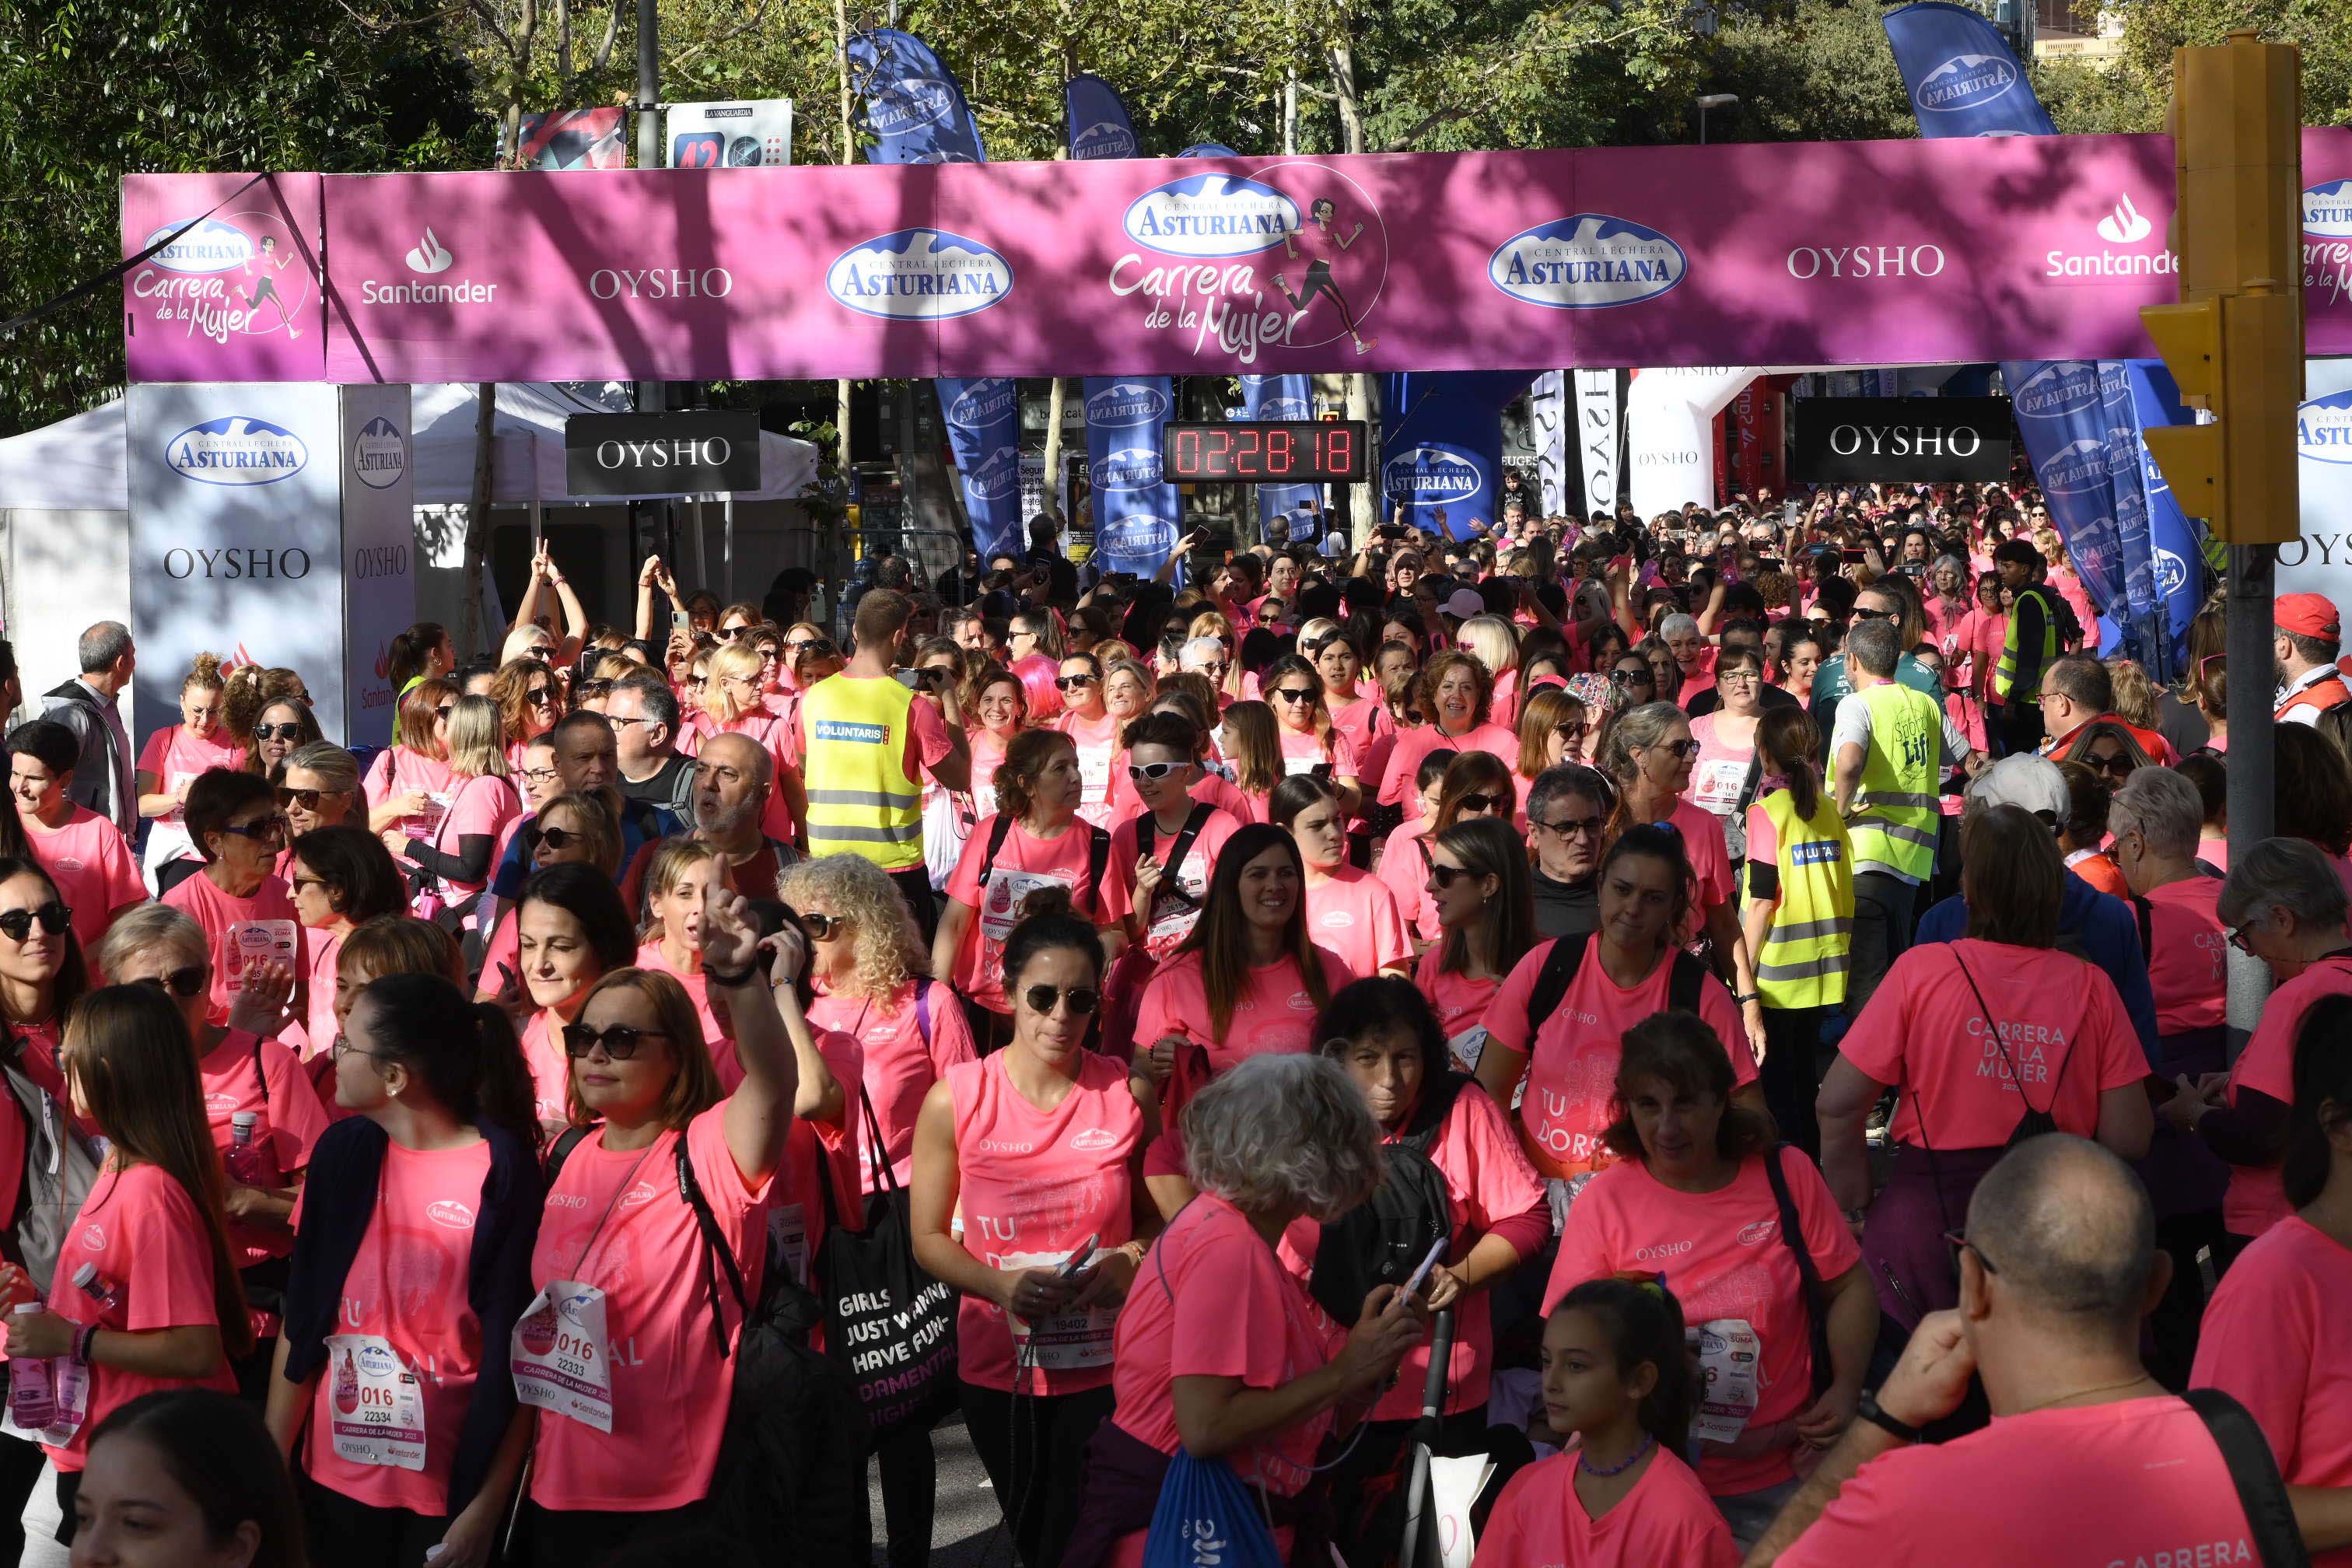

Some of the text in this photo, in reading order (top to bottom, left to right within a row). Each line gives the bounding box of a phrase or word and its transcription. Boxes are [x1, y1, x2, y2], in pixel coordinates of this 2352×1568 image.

[714, 108, 752, 117] VANGUARDIA
[1164, 200, 1283, 212] CENTRAL LECHERA
[1137, 205, 1288, 236] ASTURIANA
[870, 257, 993, 270] CENTRAL LECHERA
[1534, 245, 1665, 257] CENTRAL LECHERA
[1787, 244, 1945, 279] OYSHO
[842, 264, 999, 297] ASTURIANA
[1108, 253, 1255, 297] Carrera
[1503, 250, 1672, 285] ASTURIANA
[2302, 265, 2333, 287] e la
[133, 269, 226, 299] Carrera
[362, 278, 498, 304] Santander
[589, 267, 733, 300] OYSHO
[156, 304, 189, 320] de la
[187, 296, 259, 345] Mujer
[1145, 299, 1196, 329] de la
[1193, 286, 1309, 365] Mujer
[198, 440, 293, 449] CENTRAL LECHERA
[596, 436, 732, 469] OYSHO
[1177, 430, 1351, 474] 02:28:18
[1829, 424, 1980, 457] OYSHO
[177, 442, 298, 468] ASTURIANA
[357, 449, 403, 472] ASTURIANA
[1638, 450, 1699, 467] OYSHO
[1384, 474, 1475, 492] ASTURIANA
[355, 544, 407, 579] OYSHO
[2275, 533, 2352, 566] OY
[163, 547, 311, 579] OYSHO
[816, 724, 881, 740] VOLUNTARIS
[1902, 733, 1931, 767] Lif
[1716, 782, 1738, 791] 016
[241, 934, 271, 943] ASTURIANA
[243, 954, 268, 966] 016
[1561, 1007, 1598, 1027] OSHO
[1965, 1017, 2067, 1047] CARRERA
[1983, 1038, 2046, 1064] DE LA
[1976, 1059, 2049, 1083] MUJER
[1542, 1087, 1566, 1118] TU
[978, 1139, 1033, 1153] OYSHO
[1073, 1139, 1115, 1148] ASTURIANA
[431, 1208, 472, 1227] ASTURIANA
[976, 1215, 1016, 1241] TU
[1636, 1241, 1693, 1261] OYSHO
[838, 1287, 891, 1318] GIRLS
[847, 1281, 952, 1347] JUST WANNA
[558, 1332, 594, 1360] 016
[852, 1315, 950, 1374] HAVE FUN-
[1730, 1335, 1754, 1345] SUMA
[360, 1356, 393, 1371] ASTURIANA
[557, 1357, 585, 1377] 22333
[859, 1343, 958, 1402] DAMENTAL
[516, 1381, 556, 1401] OYSHO
[523, 1364, 561, 1381] CARRERA
[558, 1376, 566, 1384] DE
[565, 1377, 574, 1388] LA
[574, 1381, 597, 1395] MUJER
[361, 1386, 394, 1407] 016
[364, 1410, 392, 1423] 22334
[579, 1402, 611, 1422] Santander
[341, 1425, 368, 1436] CARRERA
[386, 1430, 404, 1439] MUJER
[341, 1441, 371, 1455] OYSHO
[2106, 1538, 2253, 1568] ARRERA
